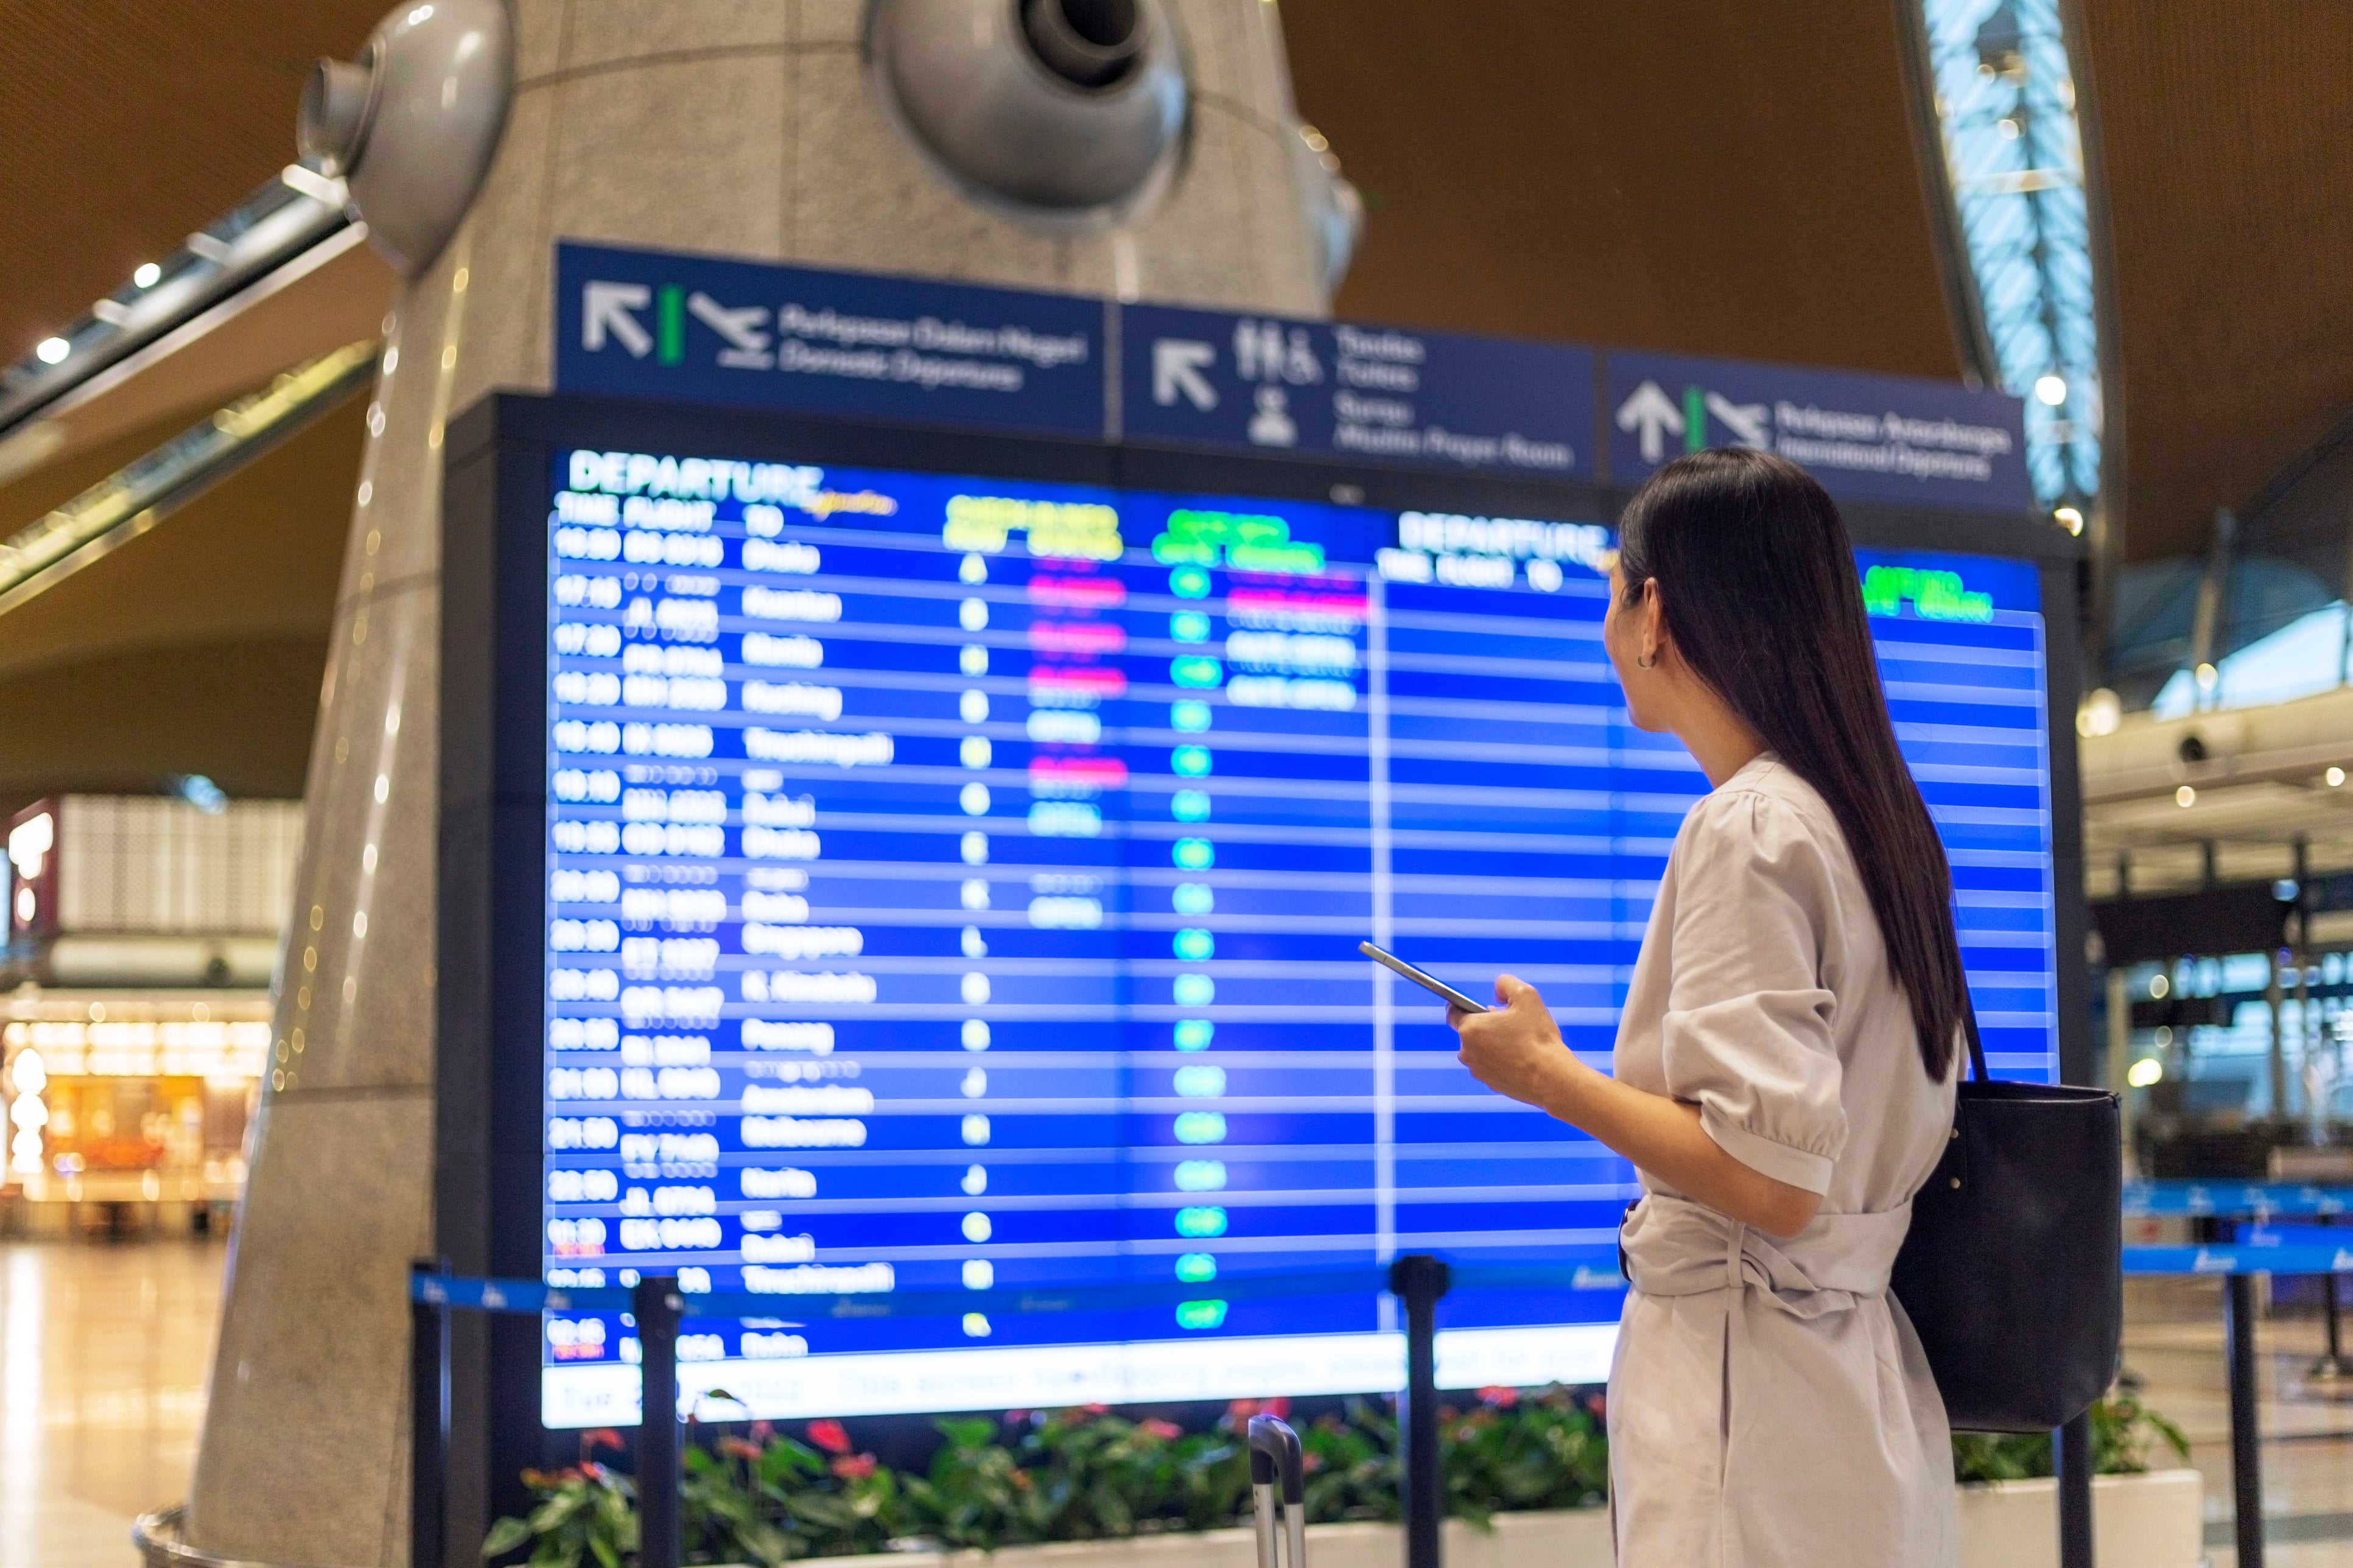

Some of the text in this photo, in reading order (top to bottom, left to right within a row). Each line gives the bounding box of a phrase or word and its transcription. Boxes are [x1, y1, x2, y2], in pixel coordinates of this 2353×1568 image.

[779, 338, 1023, 391] Domestic Departures
[914, 316, 996, 355] Dalam
[998, 324, 1089, 368] Negeri
[1423, 425, 1499, 467] Prayer
[1502, 433, 1575, 470] Room
[1776, 437, 1991, 481] International Departures
[570, 450, 824, 507] DEPARTURE
[1398, 511, 1608, 566] DEPARTURE
